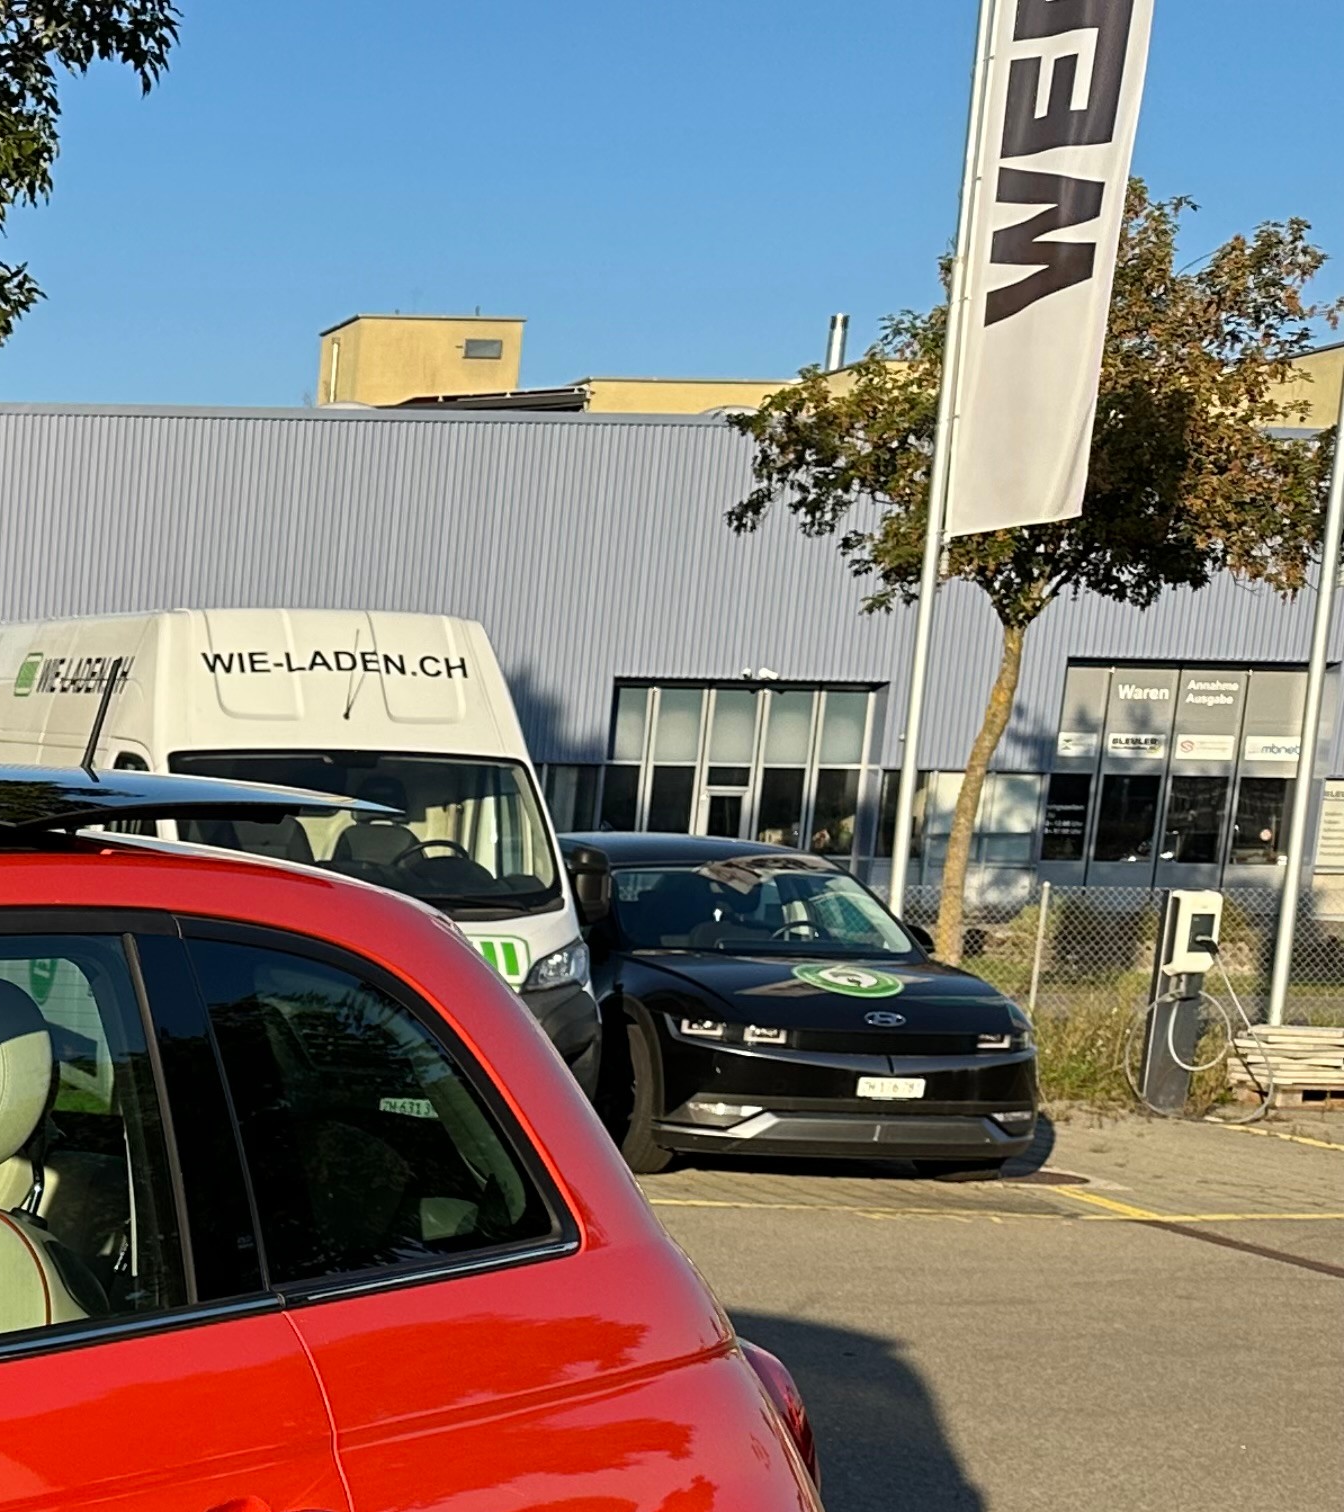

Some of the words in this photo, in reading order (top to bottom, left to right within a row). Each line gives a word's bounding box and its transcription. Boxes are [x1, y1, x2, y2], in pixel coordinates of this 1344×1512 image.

[201, 650, 469, 678] WIE-LADEN.CH
[1118, 683, 1170, 700] Waren
[1186, 679, 1239, 692] Annahme
[1185, 692, 1234, 706] Ausgabe
